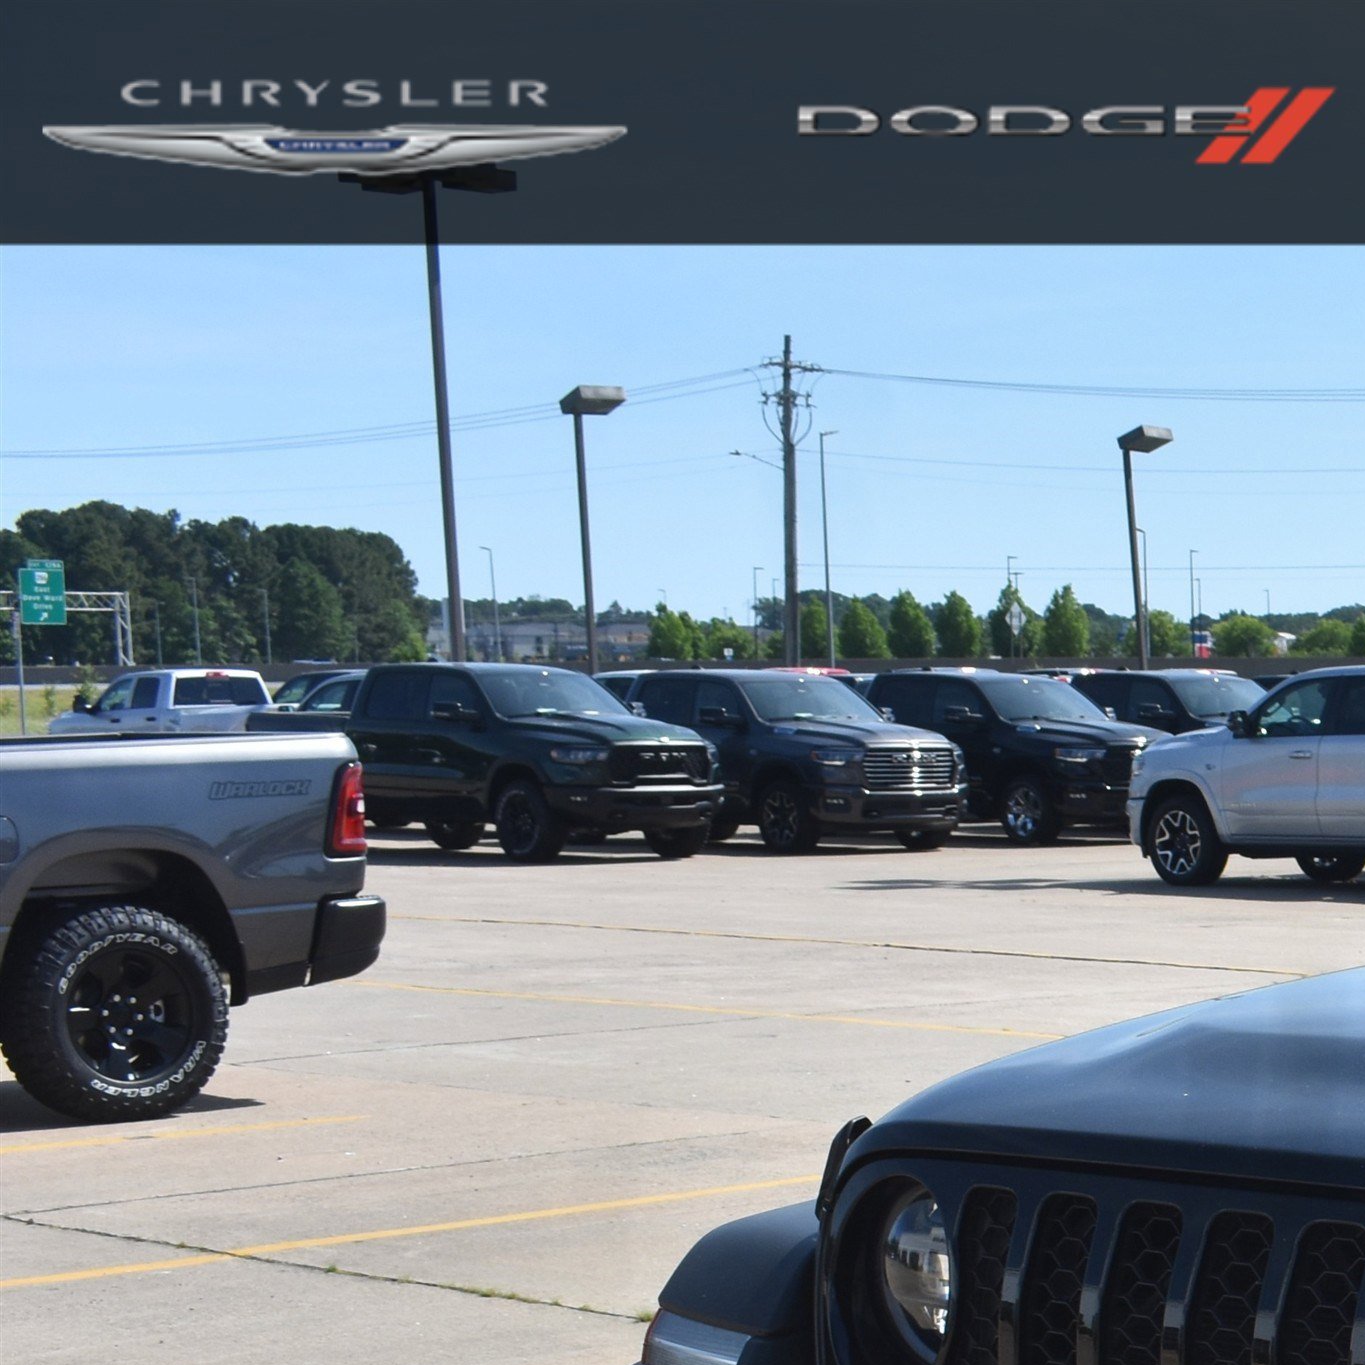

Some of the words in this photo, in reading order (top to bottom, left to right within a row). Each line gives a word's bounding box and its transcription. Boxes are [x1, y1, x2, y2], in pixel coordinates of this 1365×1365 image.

[208, 779, 312, 801] WARLOCK
[58, 932, 178, 995] GOODYEAR
[91, 1040, 207, 1098] WRANGLER
